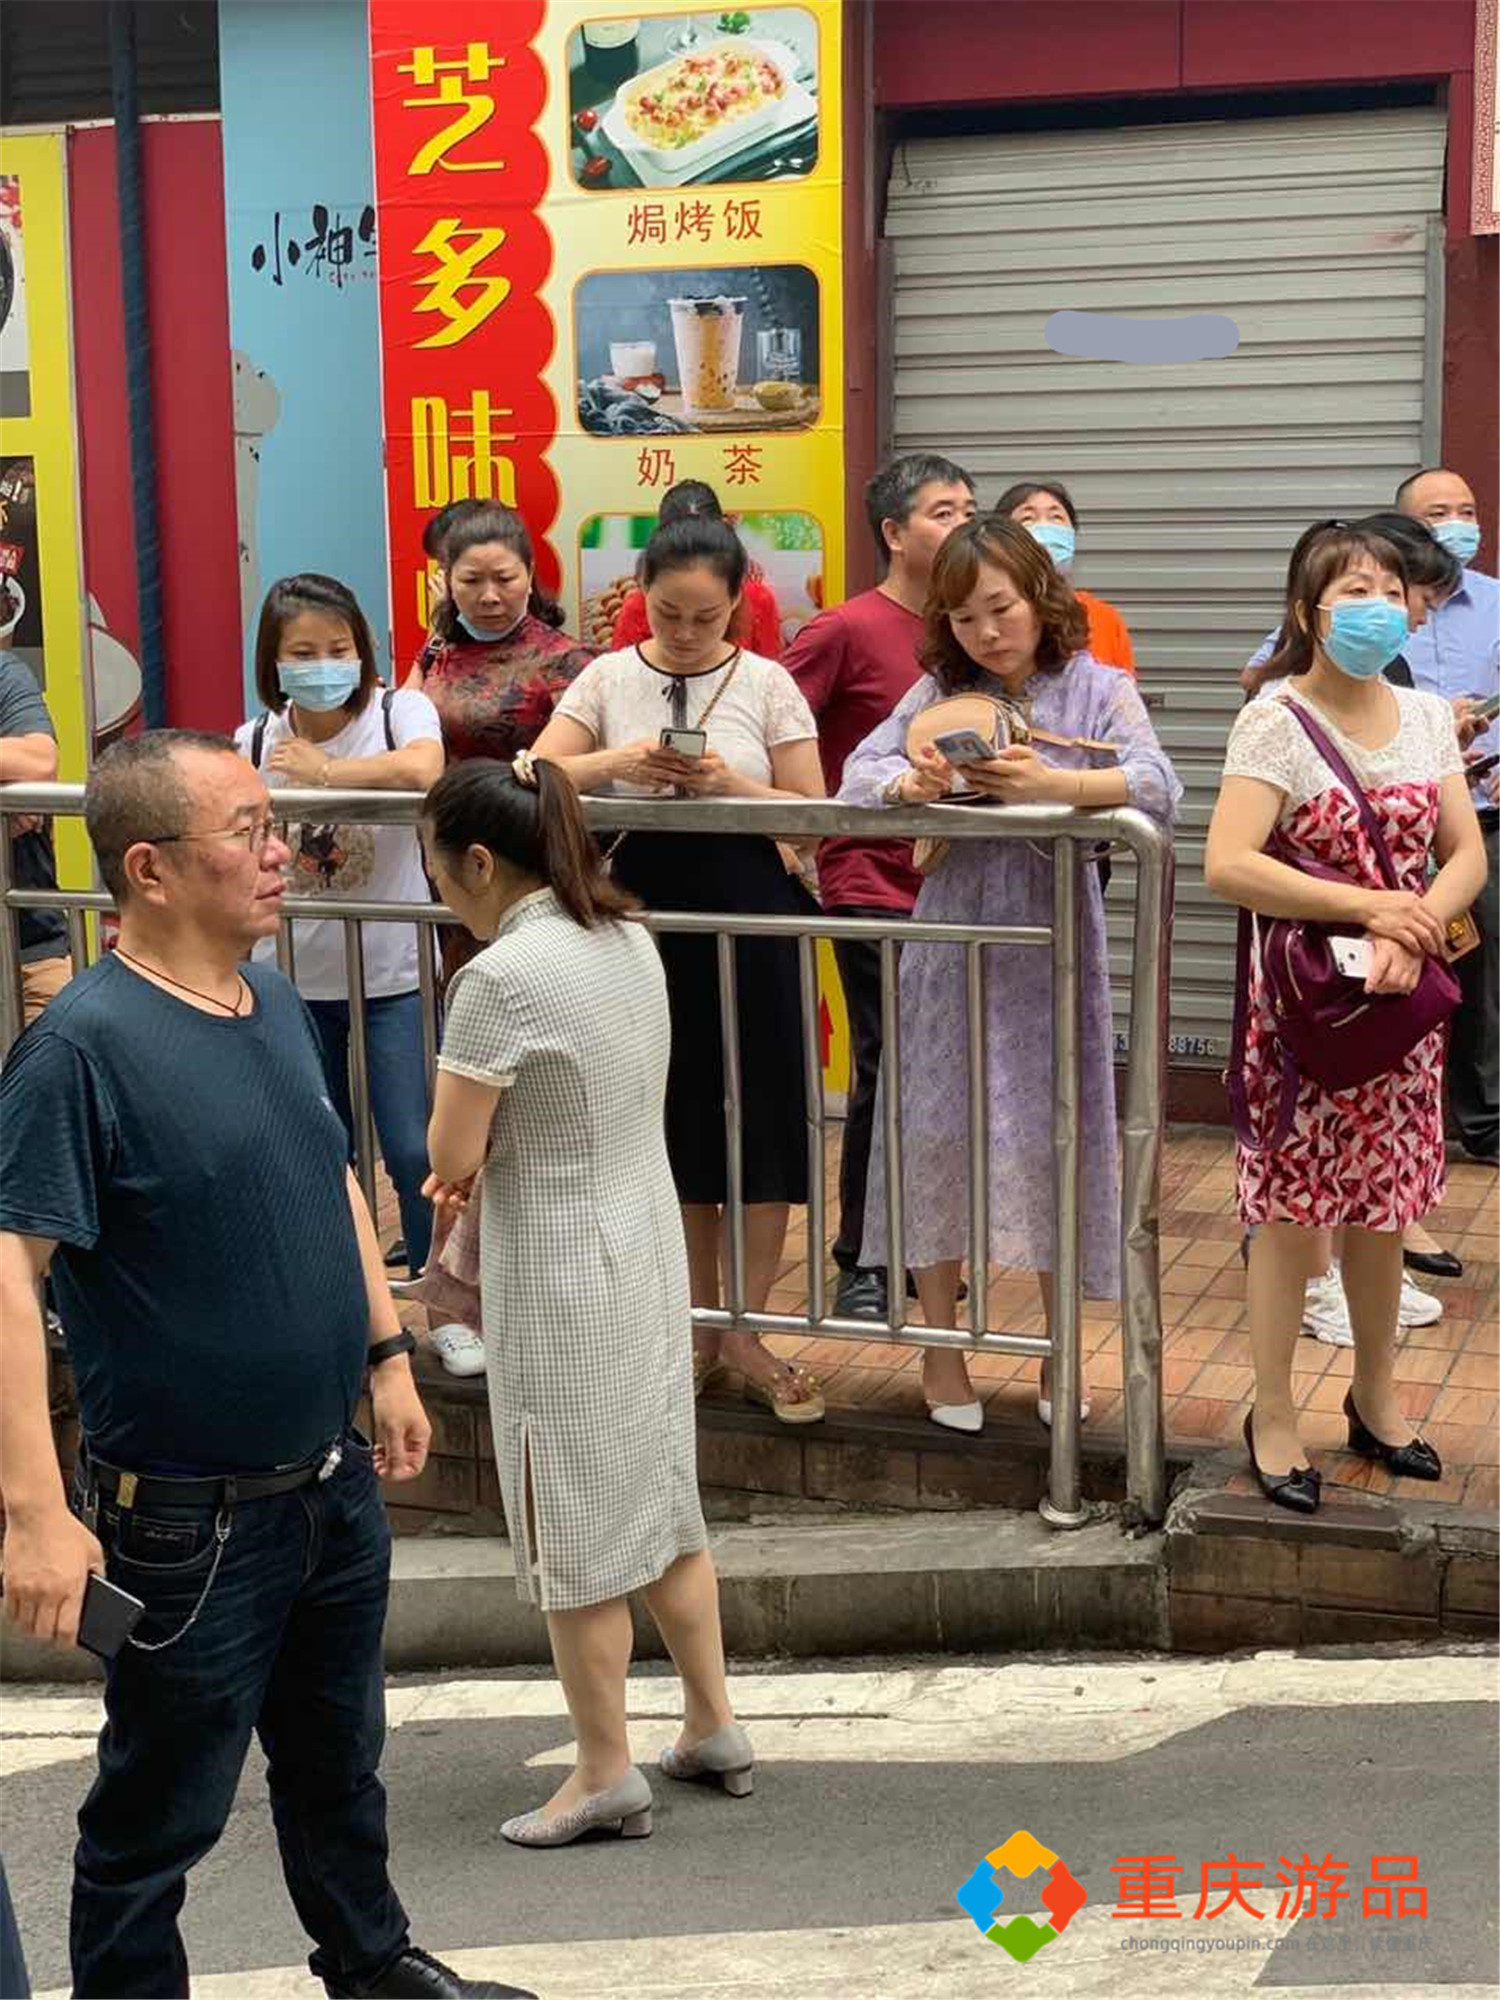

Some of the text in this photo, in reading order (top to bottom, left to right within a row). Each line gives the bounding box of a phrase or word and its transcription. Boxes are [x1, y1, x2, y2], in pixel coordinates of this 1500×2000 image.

[397, 42, 515, 632] 芝多味
[627, 199, 763, 245] 焗烤饭
